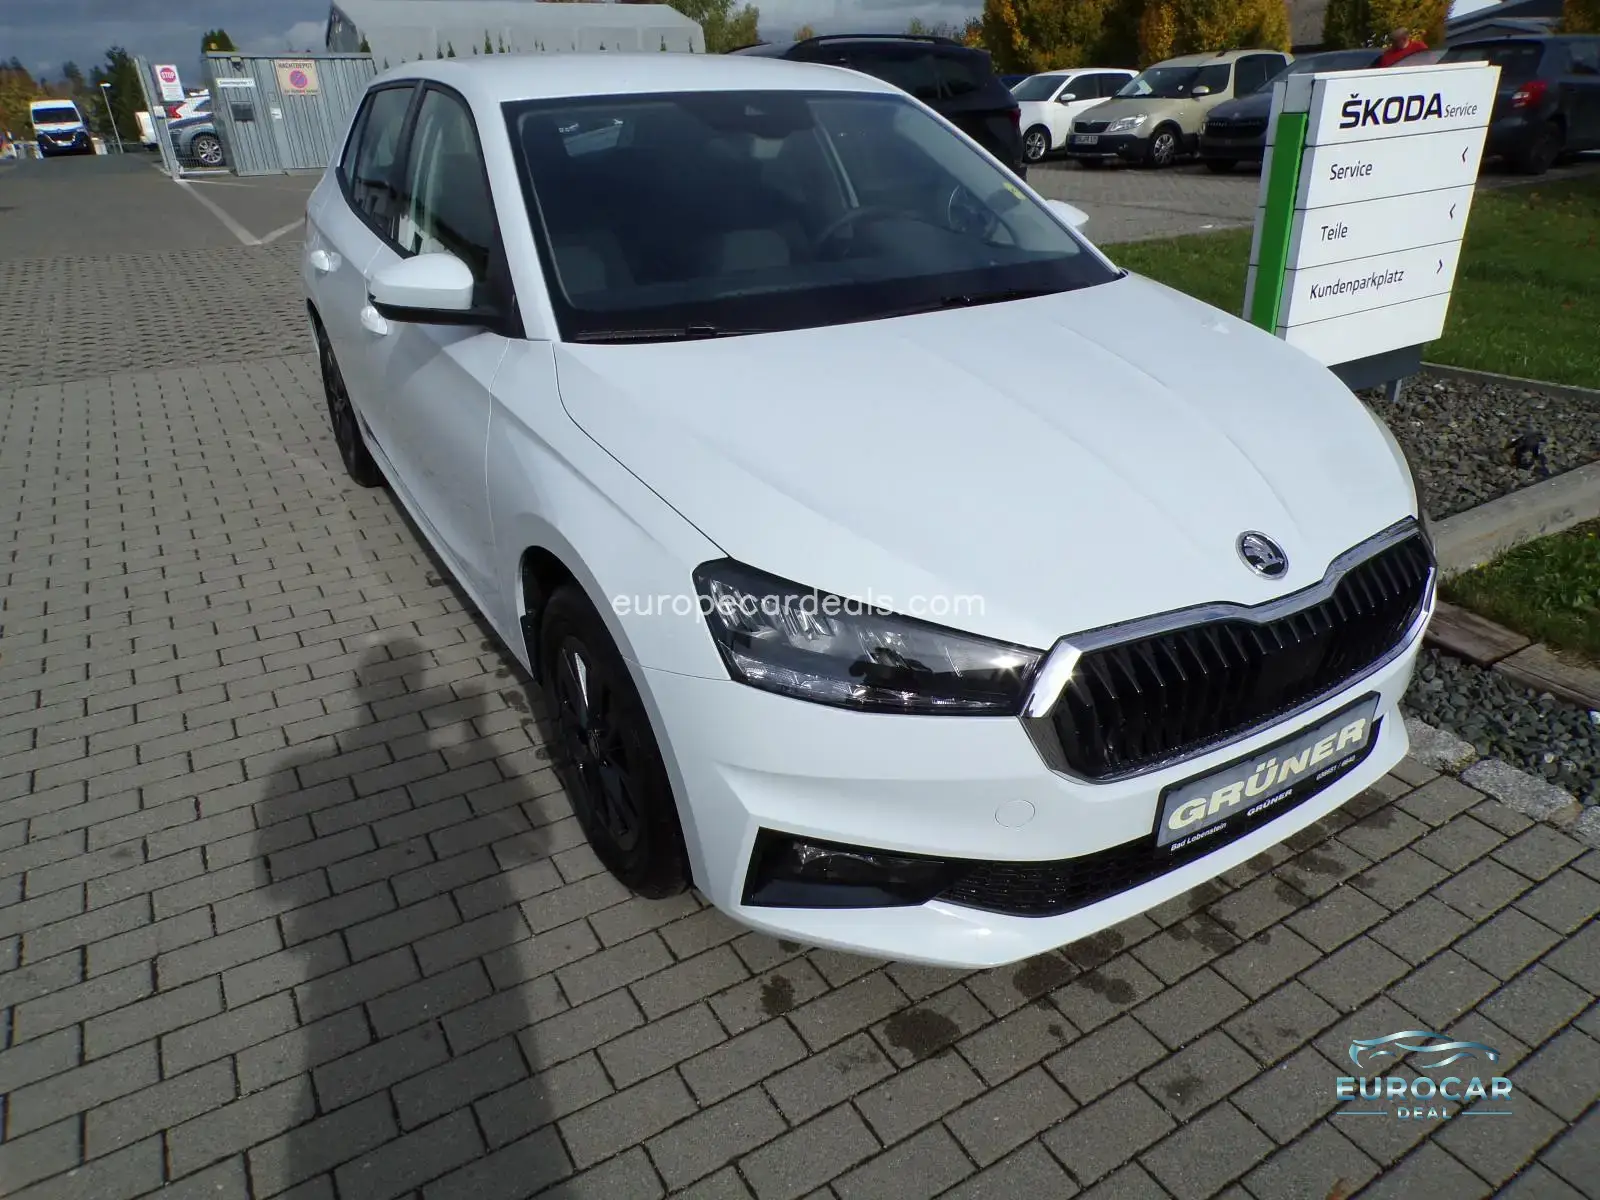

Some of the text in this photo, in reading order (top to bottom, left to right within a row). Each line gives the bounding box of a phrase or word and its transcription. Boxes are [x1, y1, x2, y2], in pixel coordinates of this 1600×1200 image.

[160, 70, 176, 80] STOP
[1339, 93, 1478, 130] ŠKODA Service
[1329, 160, 1373, 181] Service
[1320, 223, 1348, 241] Teile
[1309, 268, 1405, 300] Kundenparkplatz
[1168, 717, 1367, 830] GRÜNER
[1246, 788, 1293, 817] GRÜNER
[1170, 822, 1228, 851] Bad Lobenstein
